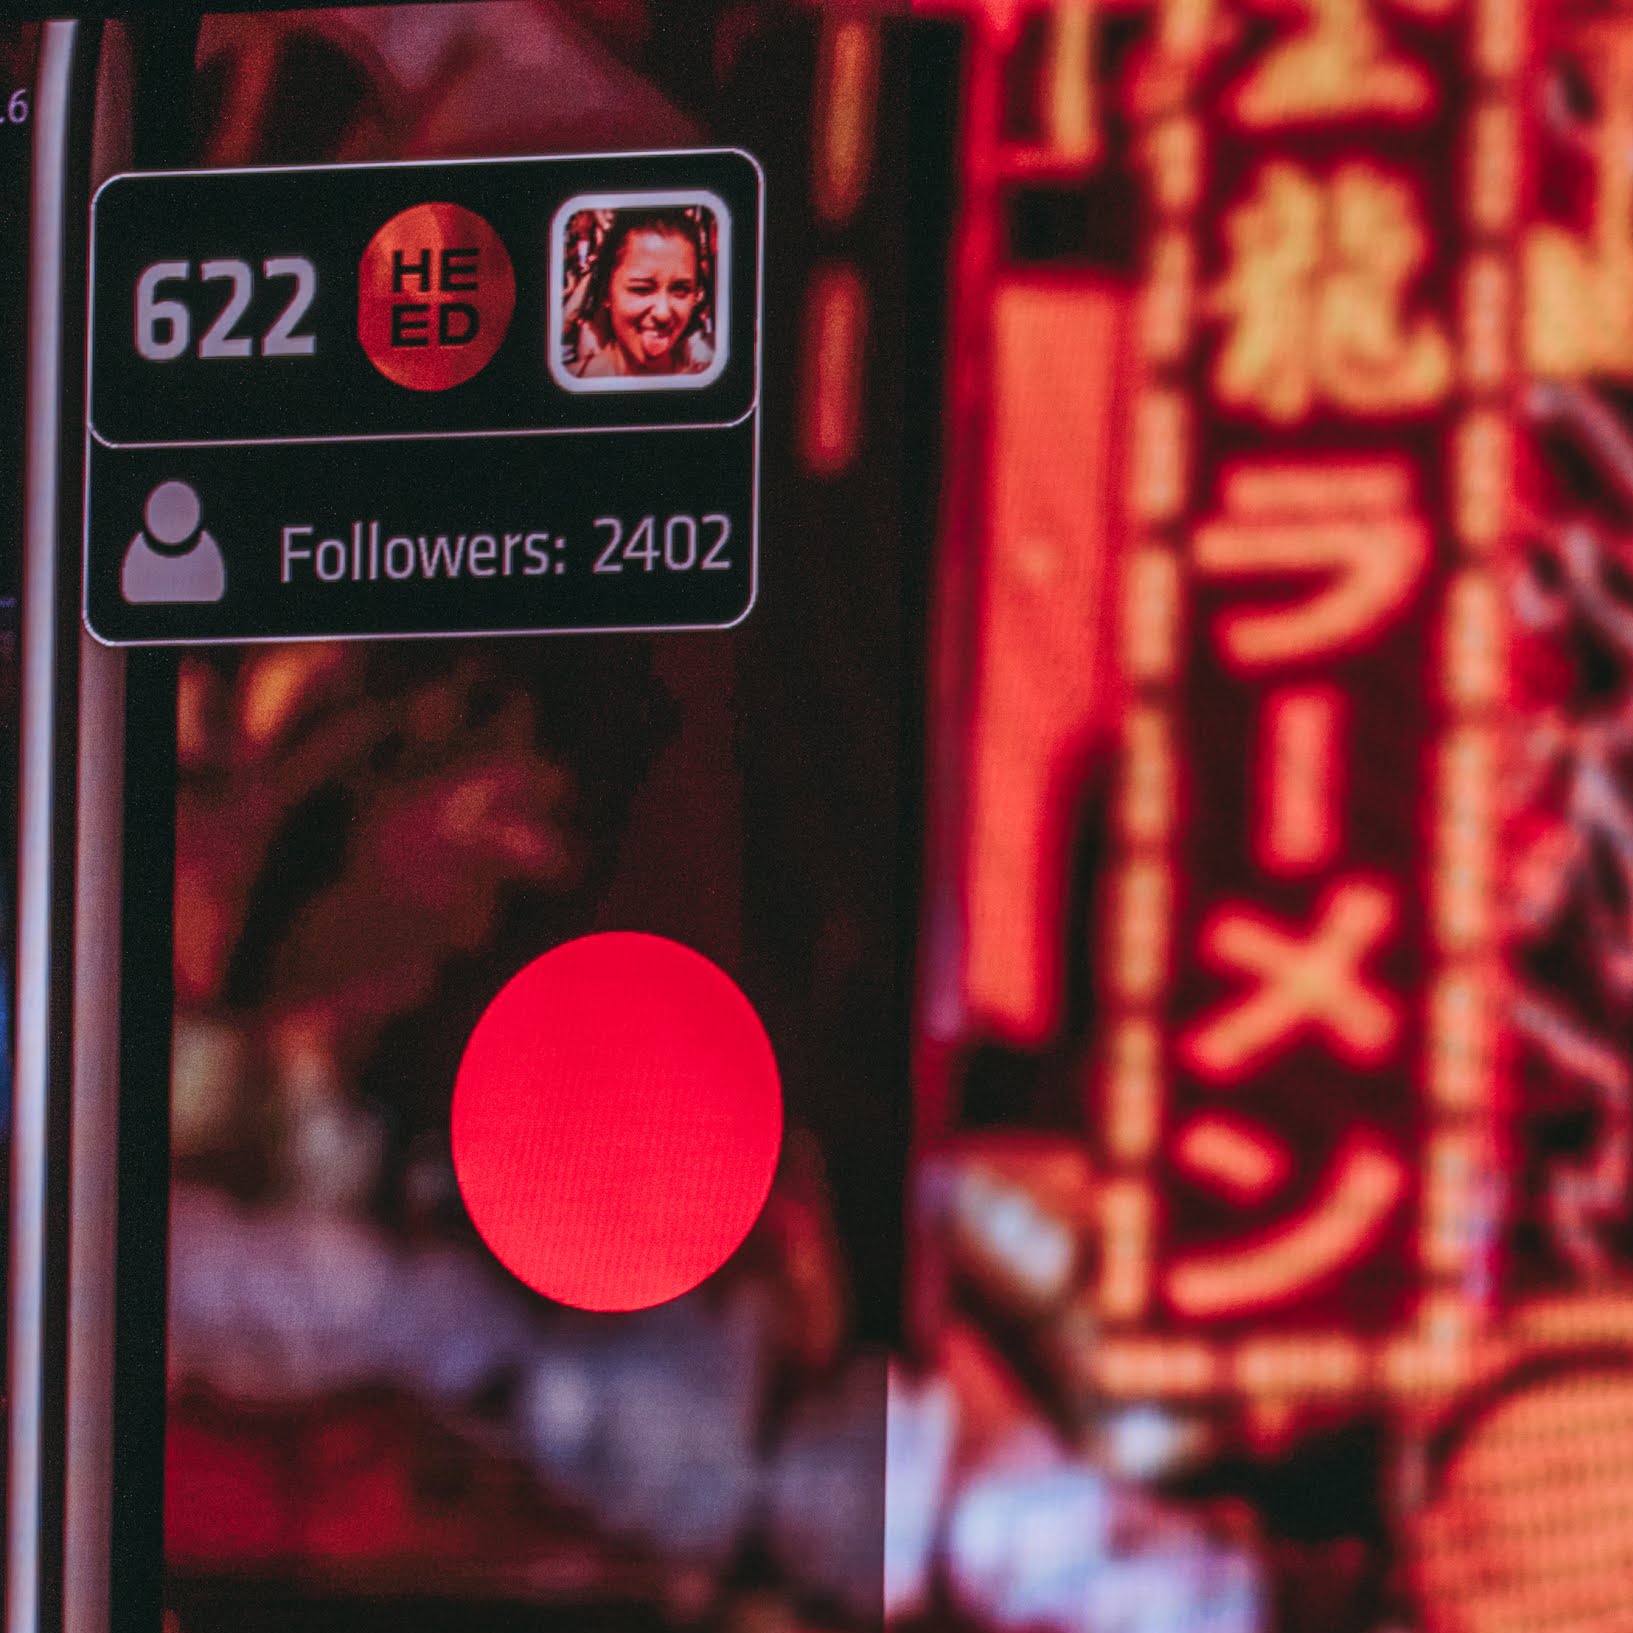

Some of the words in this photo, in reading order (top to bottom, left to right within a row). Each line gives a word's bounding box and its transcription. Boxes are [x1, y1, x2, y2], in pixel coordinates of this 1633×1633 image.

[390, 247, 479, 294] HE
[134, 258, 317, 361] 622
[390, 302, 481, 349] ED
[280, 522, 567, 584] Followers:
[592, 513, 732, 574] 2402
